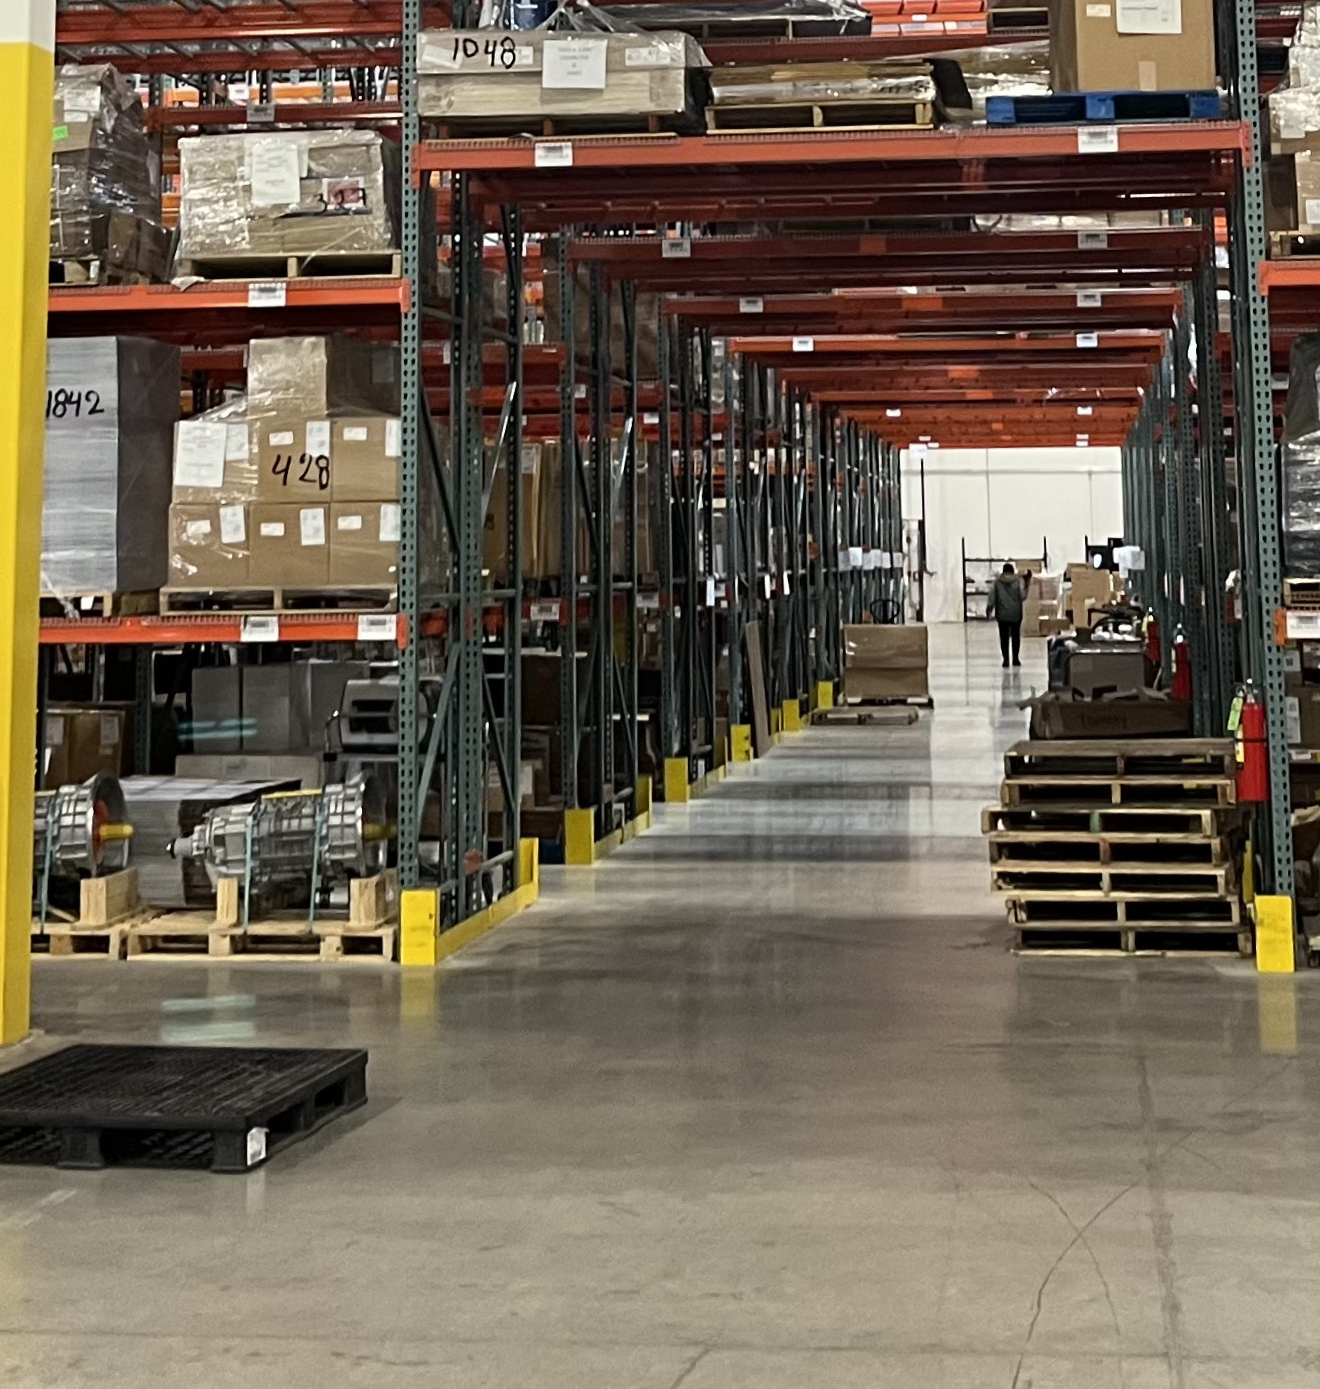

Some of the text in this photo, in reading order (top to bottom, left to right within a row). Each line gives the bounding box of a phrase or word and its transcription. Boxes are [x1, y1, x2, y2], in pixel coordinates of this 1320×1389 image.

[452, 36, 517, 70] 1048
[45, 387, 105, 419] 1842
[271, 453, 331, 491] 428
